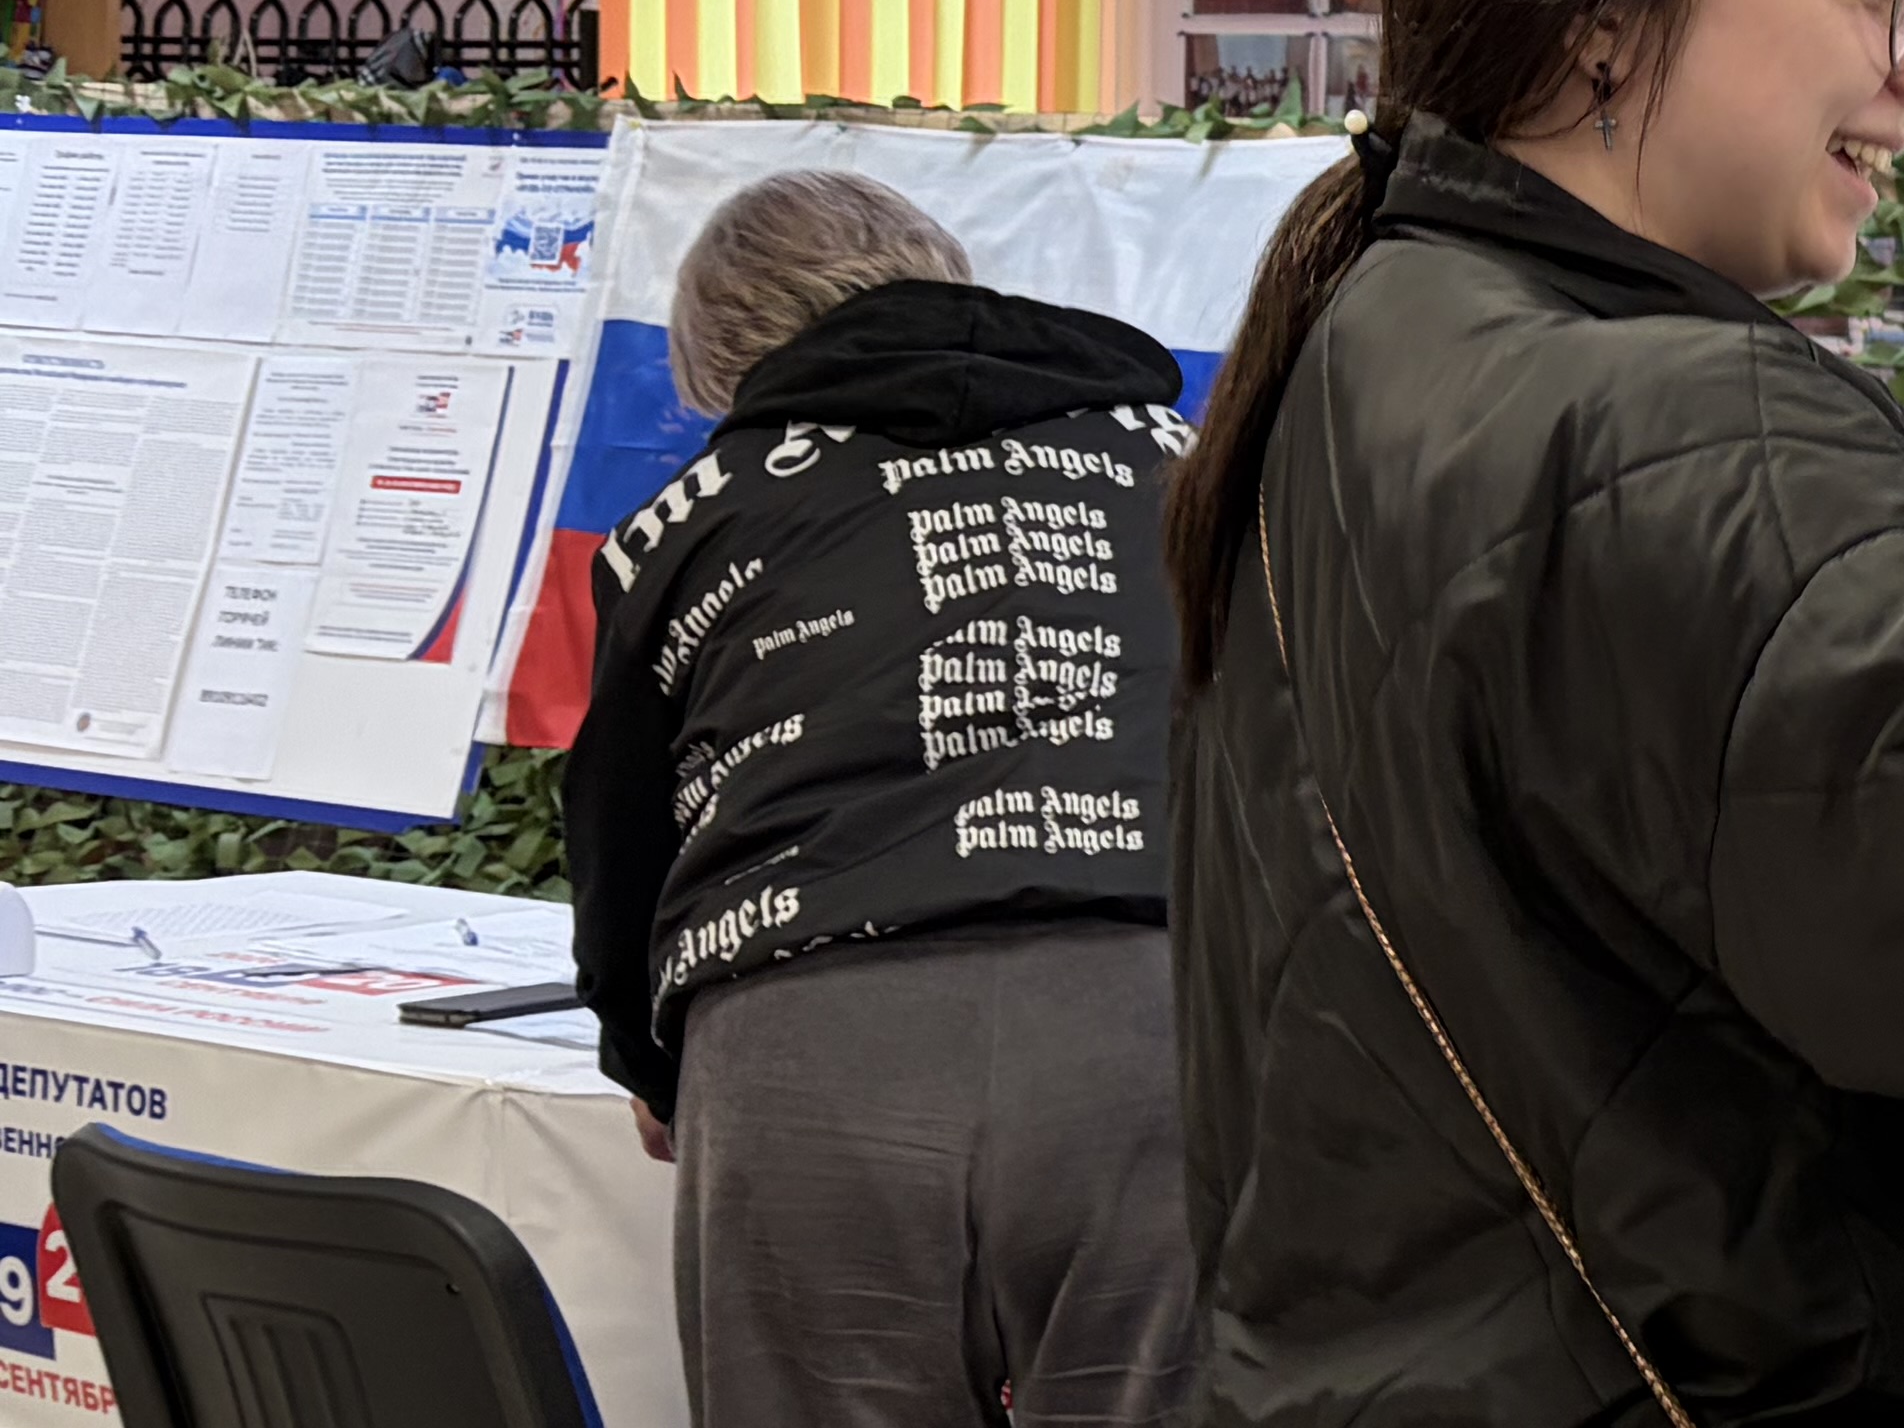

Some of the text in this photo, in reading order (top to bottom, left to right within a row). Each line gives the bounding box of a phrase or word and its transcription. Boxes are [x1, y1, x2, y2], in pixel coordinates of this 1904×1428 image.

[878, 445, 996, 495] Palm
[1000, 438, 1135, 488] Angels
[907, 495, 1108, 543] Palm Angels
[913, 523, 1115, 576] Palm Angels
[919, 552, 1118, 615] Palm Angels
[751, 608, 856, 661] Palm Angels
[1013, 615, 1122, 658] Angels
[918, 651, 1118, 699] Palm Angels
[918, 689, 1006, 730] Palm
[920, 723, 1010, 772] Palm
[1040, 785, 1141, 825] Angels
[956, 819, 1145, 859] Palm Angels
[673, 884, 800, 986] Angels
[0, 1228, 82, 1326] 9 2
[0, 1358, 118, 1415] СЕНТЯБР
